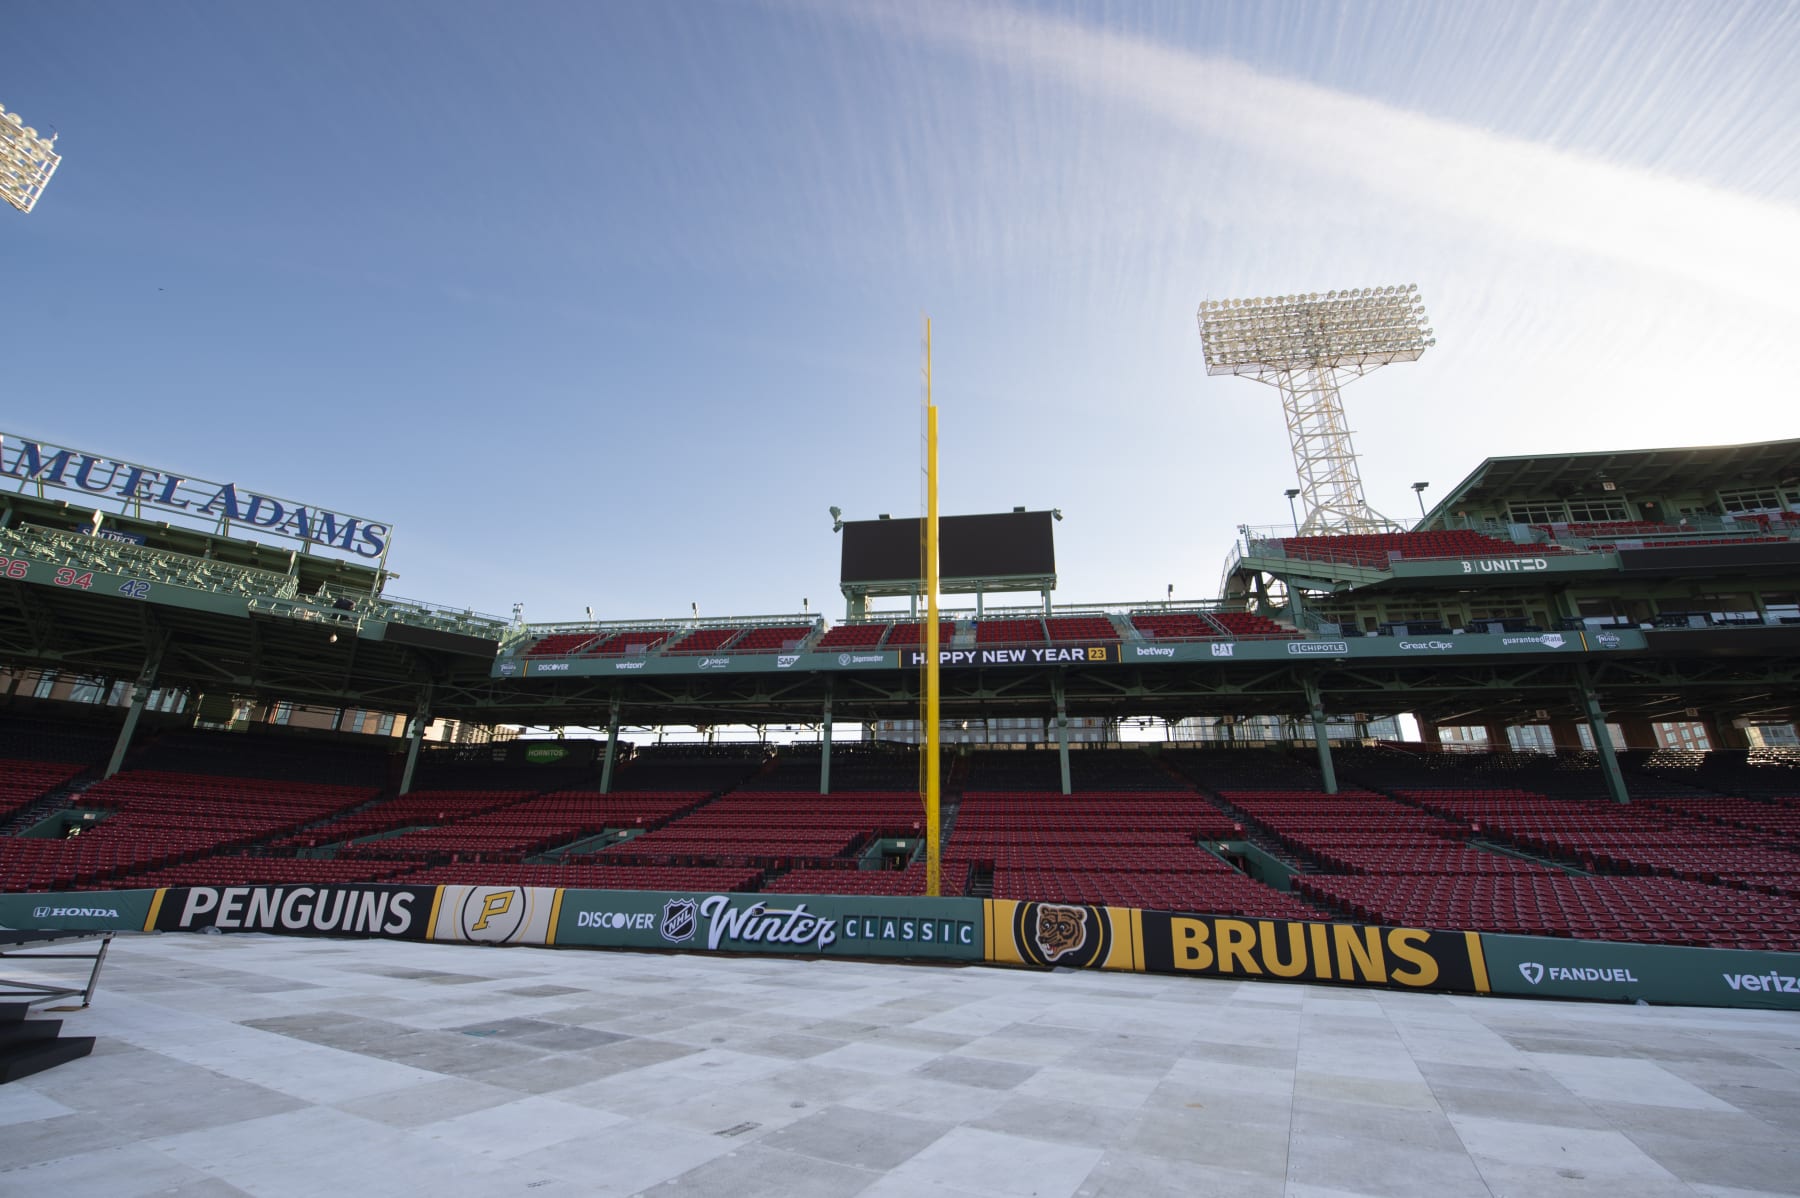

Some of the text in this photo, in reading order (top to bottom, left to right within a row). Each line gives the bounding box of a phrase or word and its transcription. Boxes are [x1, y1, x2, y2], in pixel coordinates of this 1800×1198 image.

[196, 482, 387, 558] ADAMS
[82, 528, 106, 539] SM
[1480, 558, 1548, 572] UNITED
[53, 567, 94, 590] 34
[119, 579, 150, 599] 42
[1137, 647, 1174, 656] betway
[1211, 643, 1234, 656] CAT
[1301, 643, 1345, 652] CHIPOTLE
[1400, 640, 1452, 650] Great Clips
[778, 657, 795, 665] SAP
[912, 648, 1104, 664] HPPY NEW YEAR 23
[538, 663, 569, 671] DISCOVER
[616, 661, 645, 669] verizon
[50, 908, 119, 918] HONDA
[179, 887, 416, 934] PENGUINS
[472, 890, 515, 931] P
[577, 911, 655, 929] DISCOVER
[668, 910, 691, 933] NHL
[700, 895, 972, 950] Winter CLASSIC
[1170, 916, 1439, 987] BRUINS
[1548, 967, 1638, 983] FANDUEL
[1723, 970, 1800, 993] veriz
